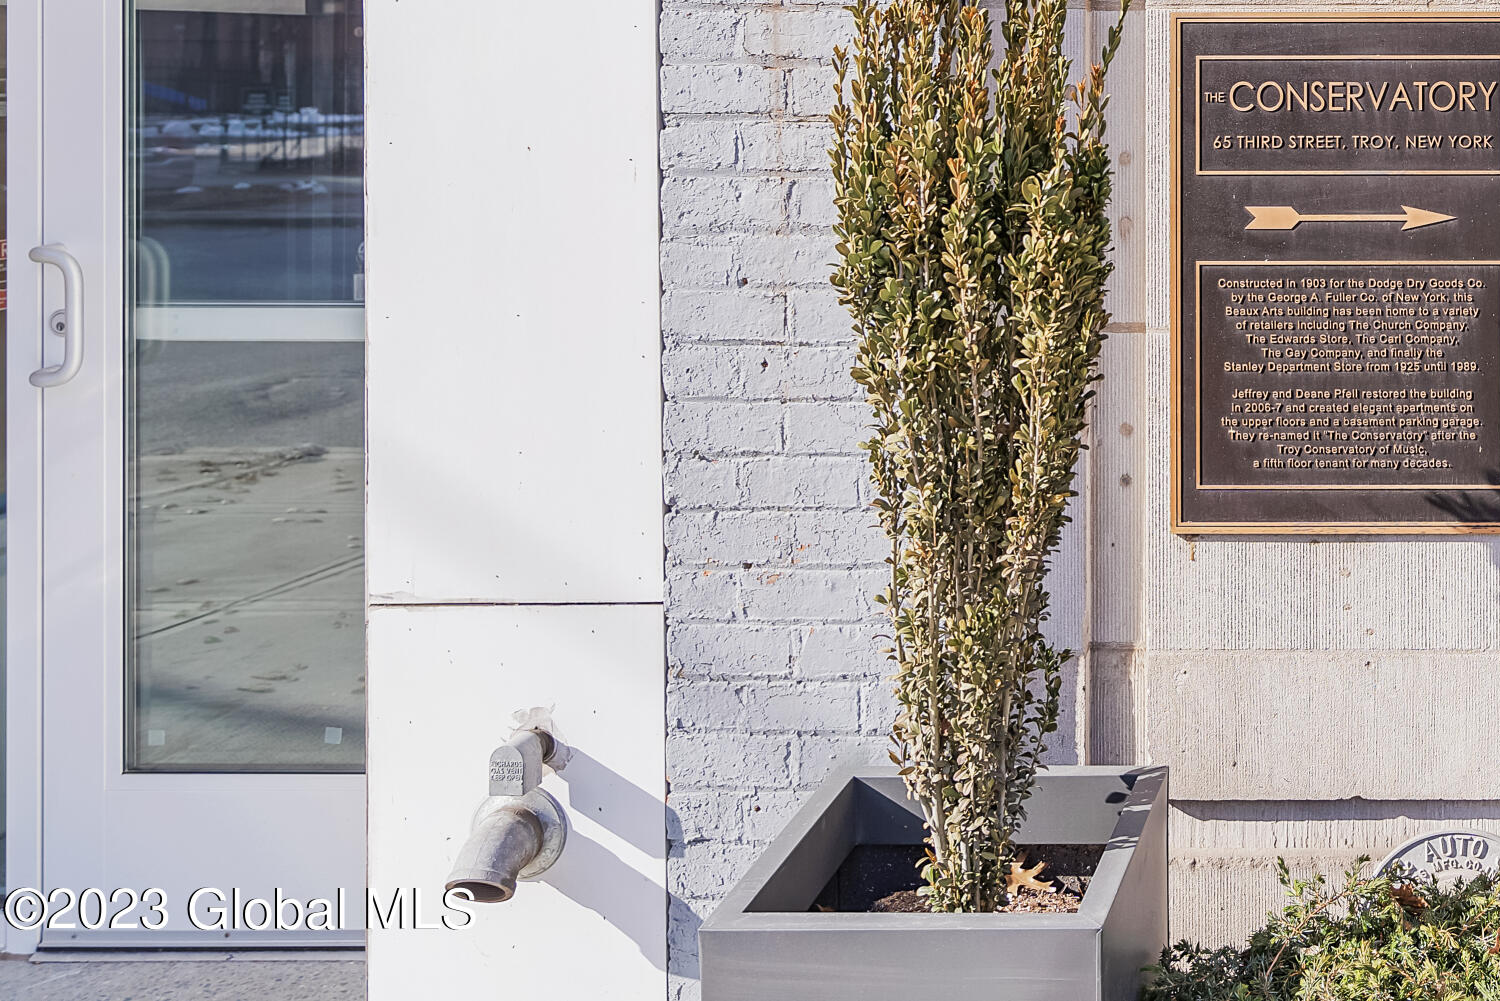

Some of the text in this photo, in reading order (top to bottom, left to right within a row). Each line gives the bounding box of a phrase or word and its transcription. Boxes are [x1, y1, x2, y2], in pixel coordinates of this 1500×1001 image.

[1204, 80, 1497, 112] THE CONSERVATORY
[1213, 135, 1494, 150] 65 THIRD STREET, TROY, NEW YORK
[1218, 278, 1486, 291] Constructed in 1903 for the Dodge Dry Goods Co.
[1231, 292, 1473, 305] by the George A. Fuller Co. of New York, this
[1225, 306, 1479, 319] Beaux Arts building has been home to a variety
[1236, 320, 1469, 333] of retailers including The Church Company,
[1246, 334, 1460, 346] The Edwards Store, The Carl Company,
[1261, 348, 1443, 360] The Gay Company, and finally the
[1224, 362, 1480, 374] Stanley Department Store from 1925 until 1989.
[1232, 388, 1473, 402] Jeffrey and Deane Pfeil restored the building
[1231, 402, 1473, 415] in 2006-7 and created elegant apartments on
[1220, 416, 1483, 429] the upper floors and a basement parking garage.
[1229, 430, 1476, 443] They re-named it "The Conservatory" after the
[1277, 444, 1428, 457] Troy Conservatory of Music,
[1253, 458, 1452, 471] a fifth floor tenant for many decades.
[1425, 835, 1489, 863] AUTO
